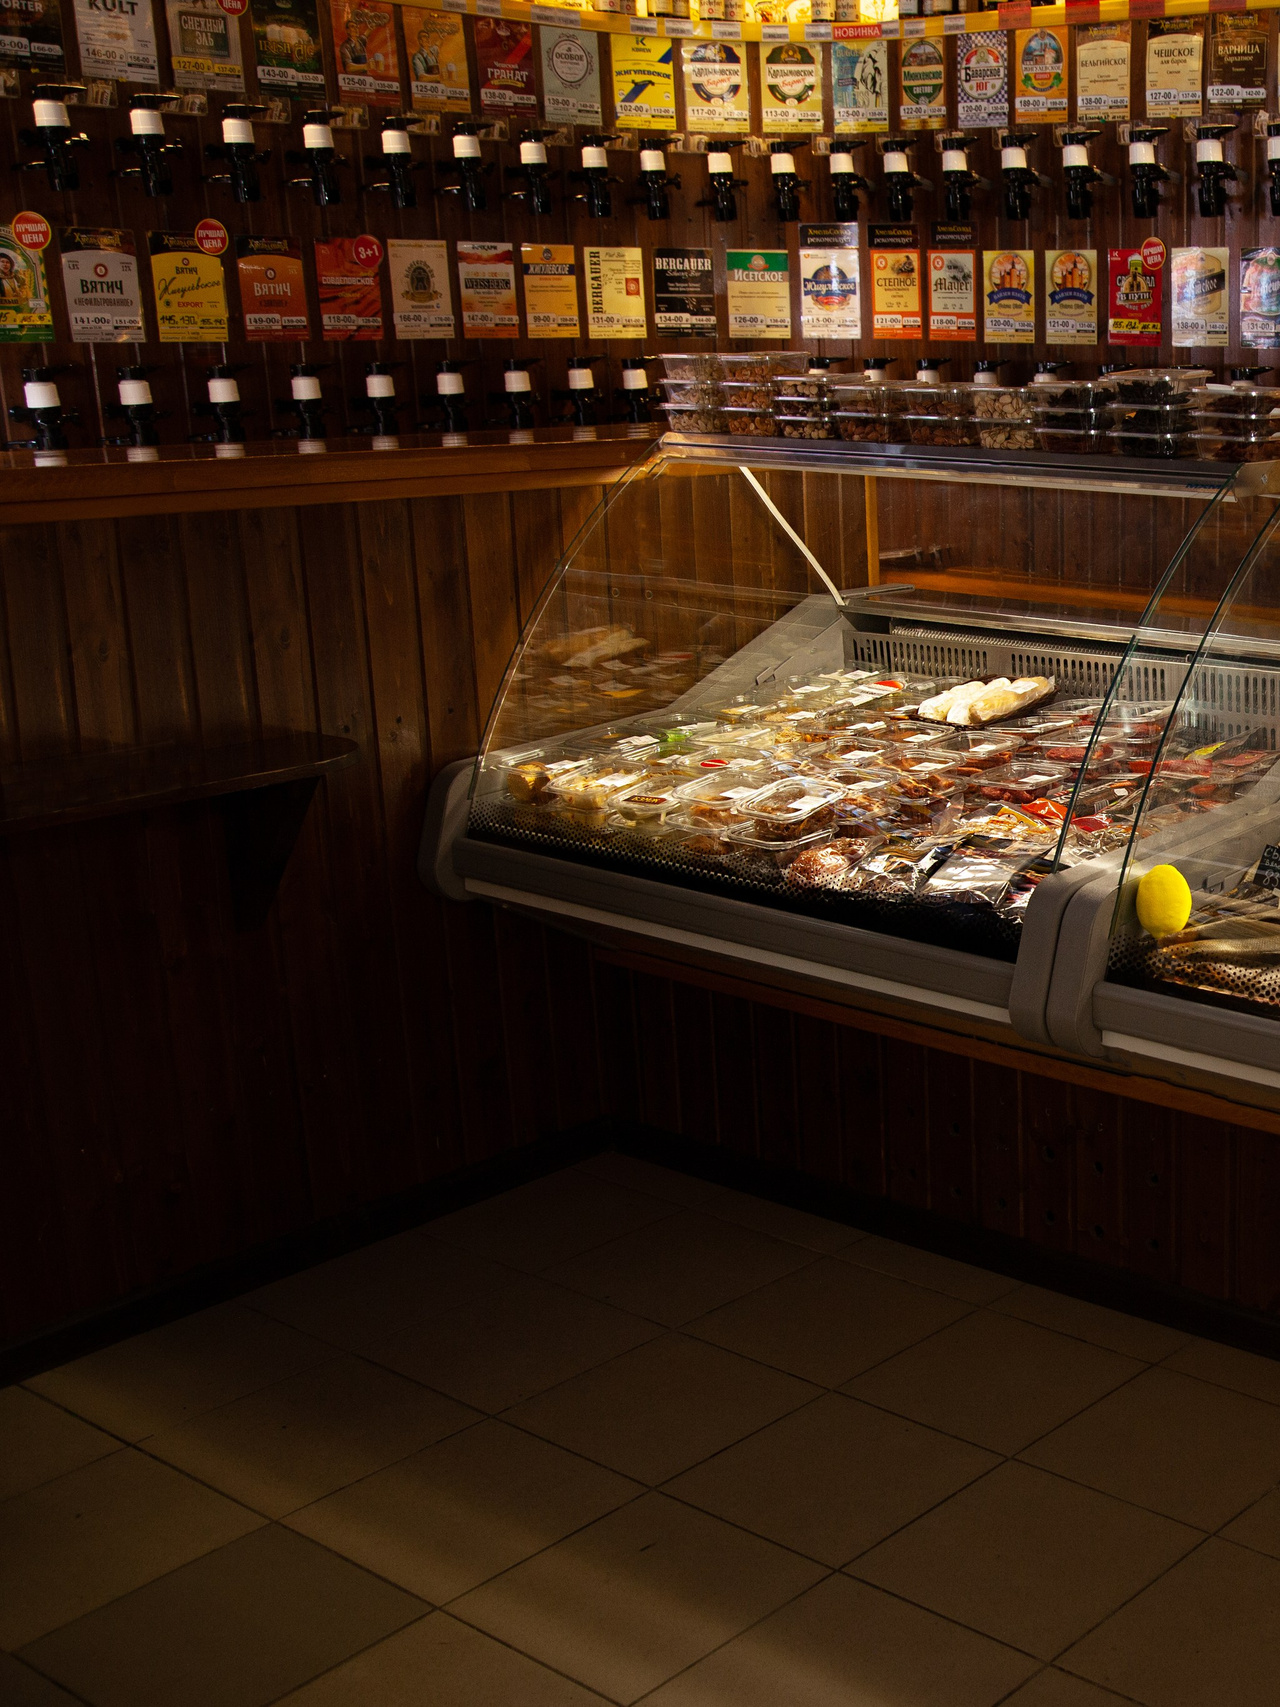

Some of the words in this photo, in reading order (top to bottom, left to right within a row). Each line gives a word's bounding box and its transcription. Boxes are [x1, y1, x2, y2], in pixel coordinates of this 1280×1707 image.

[180, 15, 225, 34] СНЕЖНЫЙ
[834, 26, 880, 38] НОВИНКА
[195, 31, 214, 47] ЭЛЬ
[85, 47, 117, 60] 146-00
[1154, 47, 1195, 59] ЧЕШСКОЕ
[1218, 45, 1261, 56] ВАРНИЦА
[555, 52, 585, 62] ОСОБОЕ
[176, 60, 205, 71] 127-00
[1080, 57, 1127, 71] БЕЛЬГИЙСКОЕ
[261, 69, 289, 79] 143-00
[487, 67, 529, 82] ГРАНАТ
[903, 68, 943, 83] Мюнхенское
[964, 65, 1001, 82] Баварское
[342, 77, 368, 88] 125-00
[415, 84, 439, 94] 125-00
[1211, 88, 1235, 97] 132-00
[484, 91, 508, 101] 138-00
[548, 96, 571, 106] 139-00
[1150, 91, 1172, 101] 127-00
[1081, 97, 1104, 106] 138-00
[620, 104, 645, 114] 102-00
[692, 108, 717, 116] 117-00
[903, 105, 924, 115] 122-00
[962, 104, 984, 114] 120-00
[764, 111, 790, 119] 113-00
[15, 223, 47, 233] ЛУЧШАЯ
[198, 229, 225, 238] ЛУЧШАЯ
[22, 234, 45, 244] ЦЕНА
[203, 238, 223, 249] ЦЕНА
[358, 244, 380, 259] 3+1
[655, 257, 712, 271] BERGAUER
[1147, 255, 1163, 266] ЦЕНА
[175, 265, 198, 276] ВЯТИЧ
[80, 279, 124, 295] ВЯТИЧ
[589, 250, 604, 314] BERGAUER
[876, 277, 917, 287] СТЕПНОЕ
[253, 281, 291, 296] ВЯТИЧ
[74, 316, 106, 325] 141-00
[248, 317, 276, 325] 149-00
[659, 315, 684, 323] 134-00
[734, 315, 759, 324] 126-00
[990, 319, 1010, 327] 120-00
[1049, 320, 1070, 328] 121-00
[1176, 320, 1200, 330] 138-00
